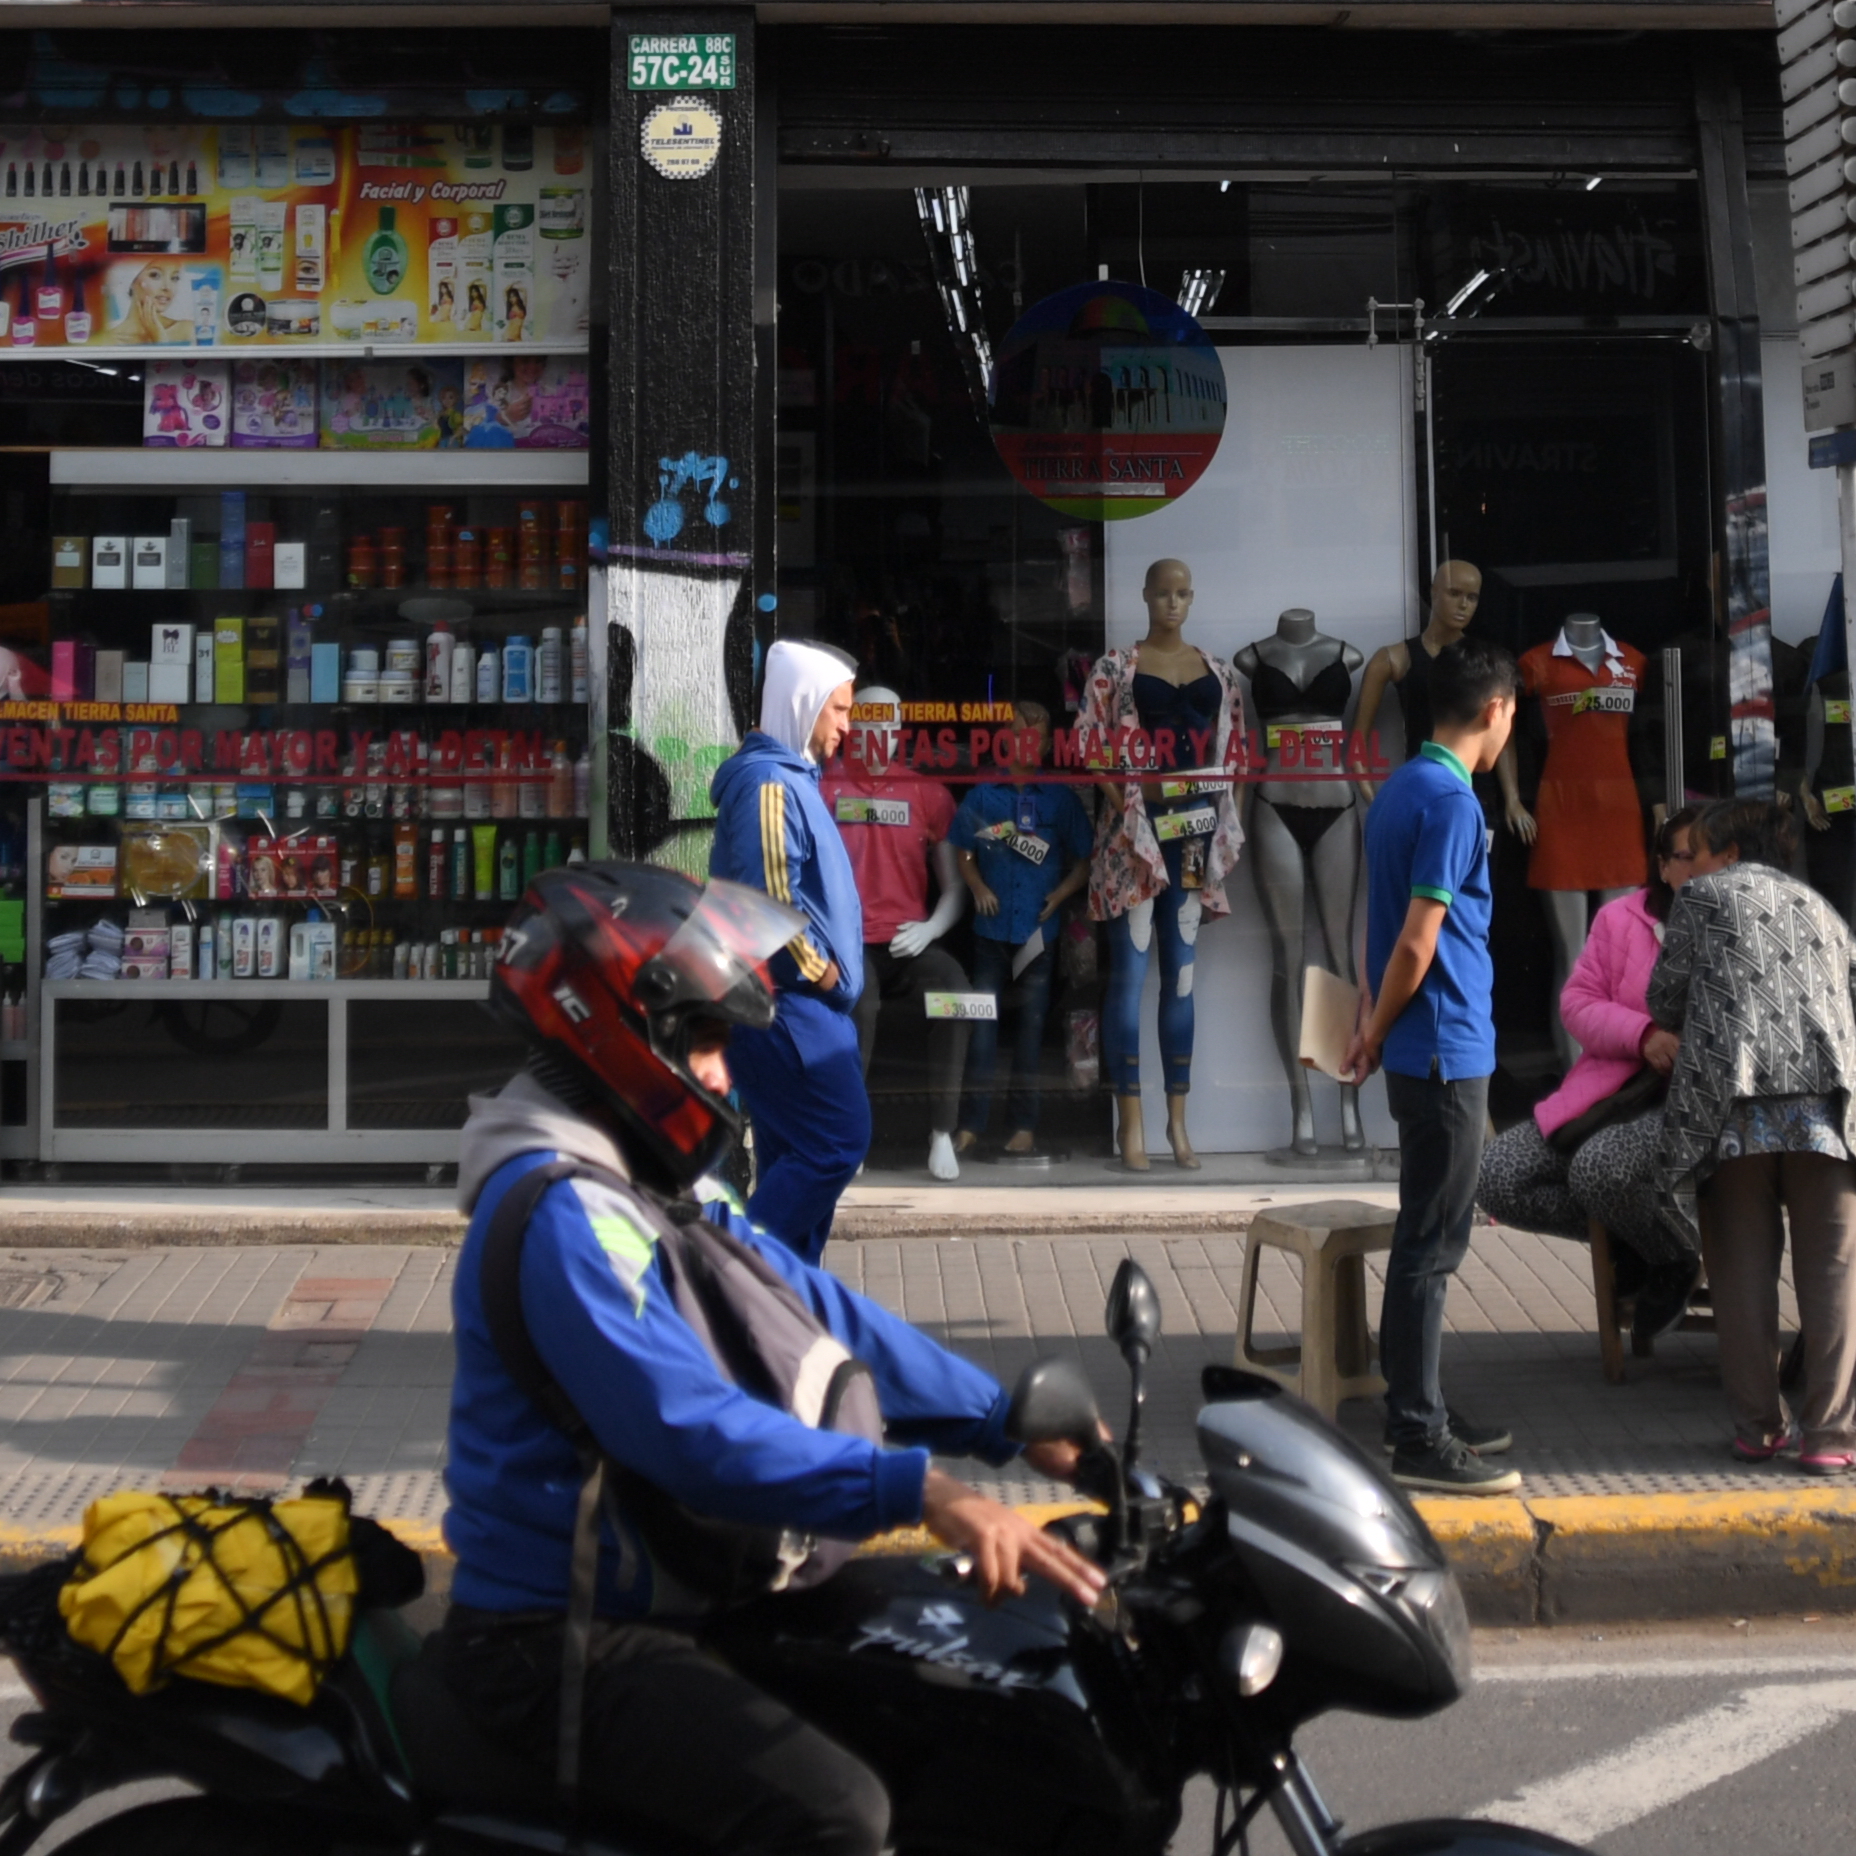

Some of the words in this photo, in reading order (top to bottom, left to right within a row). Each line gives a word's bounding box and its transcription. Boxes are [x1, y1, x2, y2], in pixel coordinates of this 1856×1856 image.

[631, 37, 698, 53] CARRERA
[705, 36, 732, 53] 88C
[632, 55, 718, 85] 57C-24
[720, 56, 731, 86] SUR
[360, 181, 411, 199] Facial
[412, 185, 426, 204] y
[431, 179, 506, 203] Corporal
[1023, 458, 1103, 480] TIERRA
[1108, 457, 1185, 480] SANTA
[62, 701, 122, 722] TIERRA
[124, 702, 179, 724] SANTA
[849, 703, 893, 722] ACEN
[900, 703, 958, 723] TIERRA
[960, 703, 1014, 723] SANTA
[129, 728, 203, 768] POR
[213, 729, 338, 770] MAYOR
[349, 729, 373, 770] Y
[383, 729, 429, 771] AL
[443, 729, 552, 771] DETAL
[846, 729, 959, 769] ENTAS
[969, 729, 1042, 769] POR
[1053, 728, 1176, 768] MAYOR
[1188, 728, 1211, 768] Y
[1222, 728, 1267, 768] AL
[1278, 729, 1391, 769] DETAL
